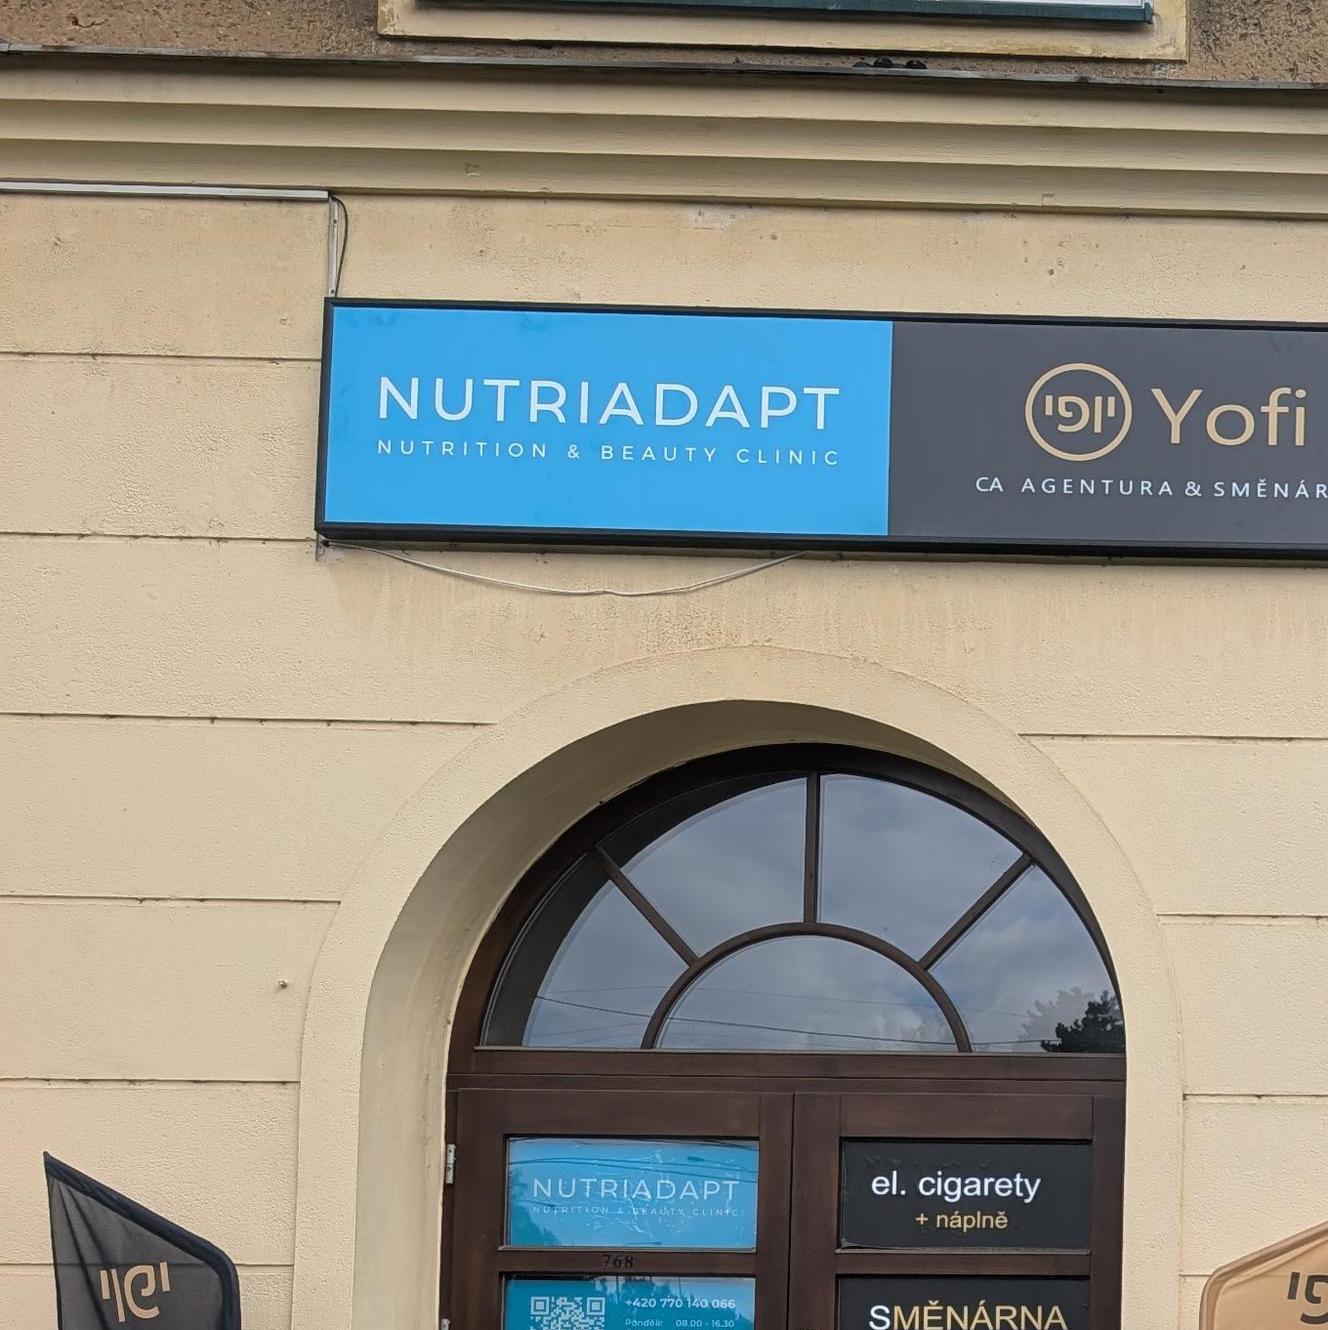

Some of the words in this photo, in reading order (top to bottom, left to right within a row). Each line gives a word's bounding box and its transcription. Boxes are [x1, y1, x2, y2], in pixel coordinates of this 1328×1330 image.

[378, 375, 839, 430] NUTRIADAPT
[1151, 387, 1308, 447] Yofi
[378, 440, 546, 459] NUTRITION
[568, 444, 580, 460] &
[601, 445, 717, 463] BEAUTY
[737, 448, 839, 466] CLINIC
[976, 476, 1003, 492] CA
[1021, 477, 1173, 496] AGENTURA
[1185, 480, 1202, 497] &
[532, 1178, 740, 1200] NUTRIADAPT
[871, 1172, 906, 1196] el.
[918, 1171, 1041, 1203] cigarety
[532, 1206, 609, 1215] NUTRITION
[936, 1211, 1008, 1231] náplně
[602, 1254, 634, 1269] 768
[660, 1299, 683, 1308] 770
[687, 1299, 708, 1308] 140
[868, 1300, 1068, 1330] SMĚNÁRNA
